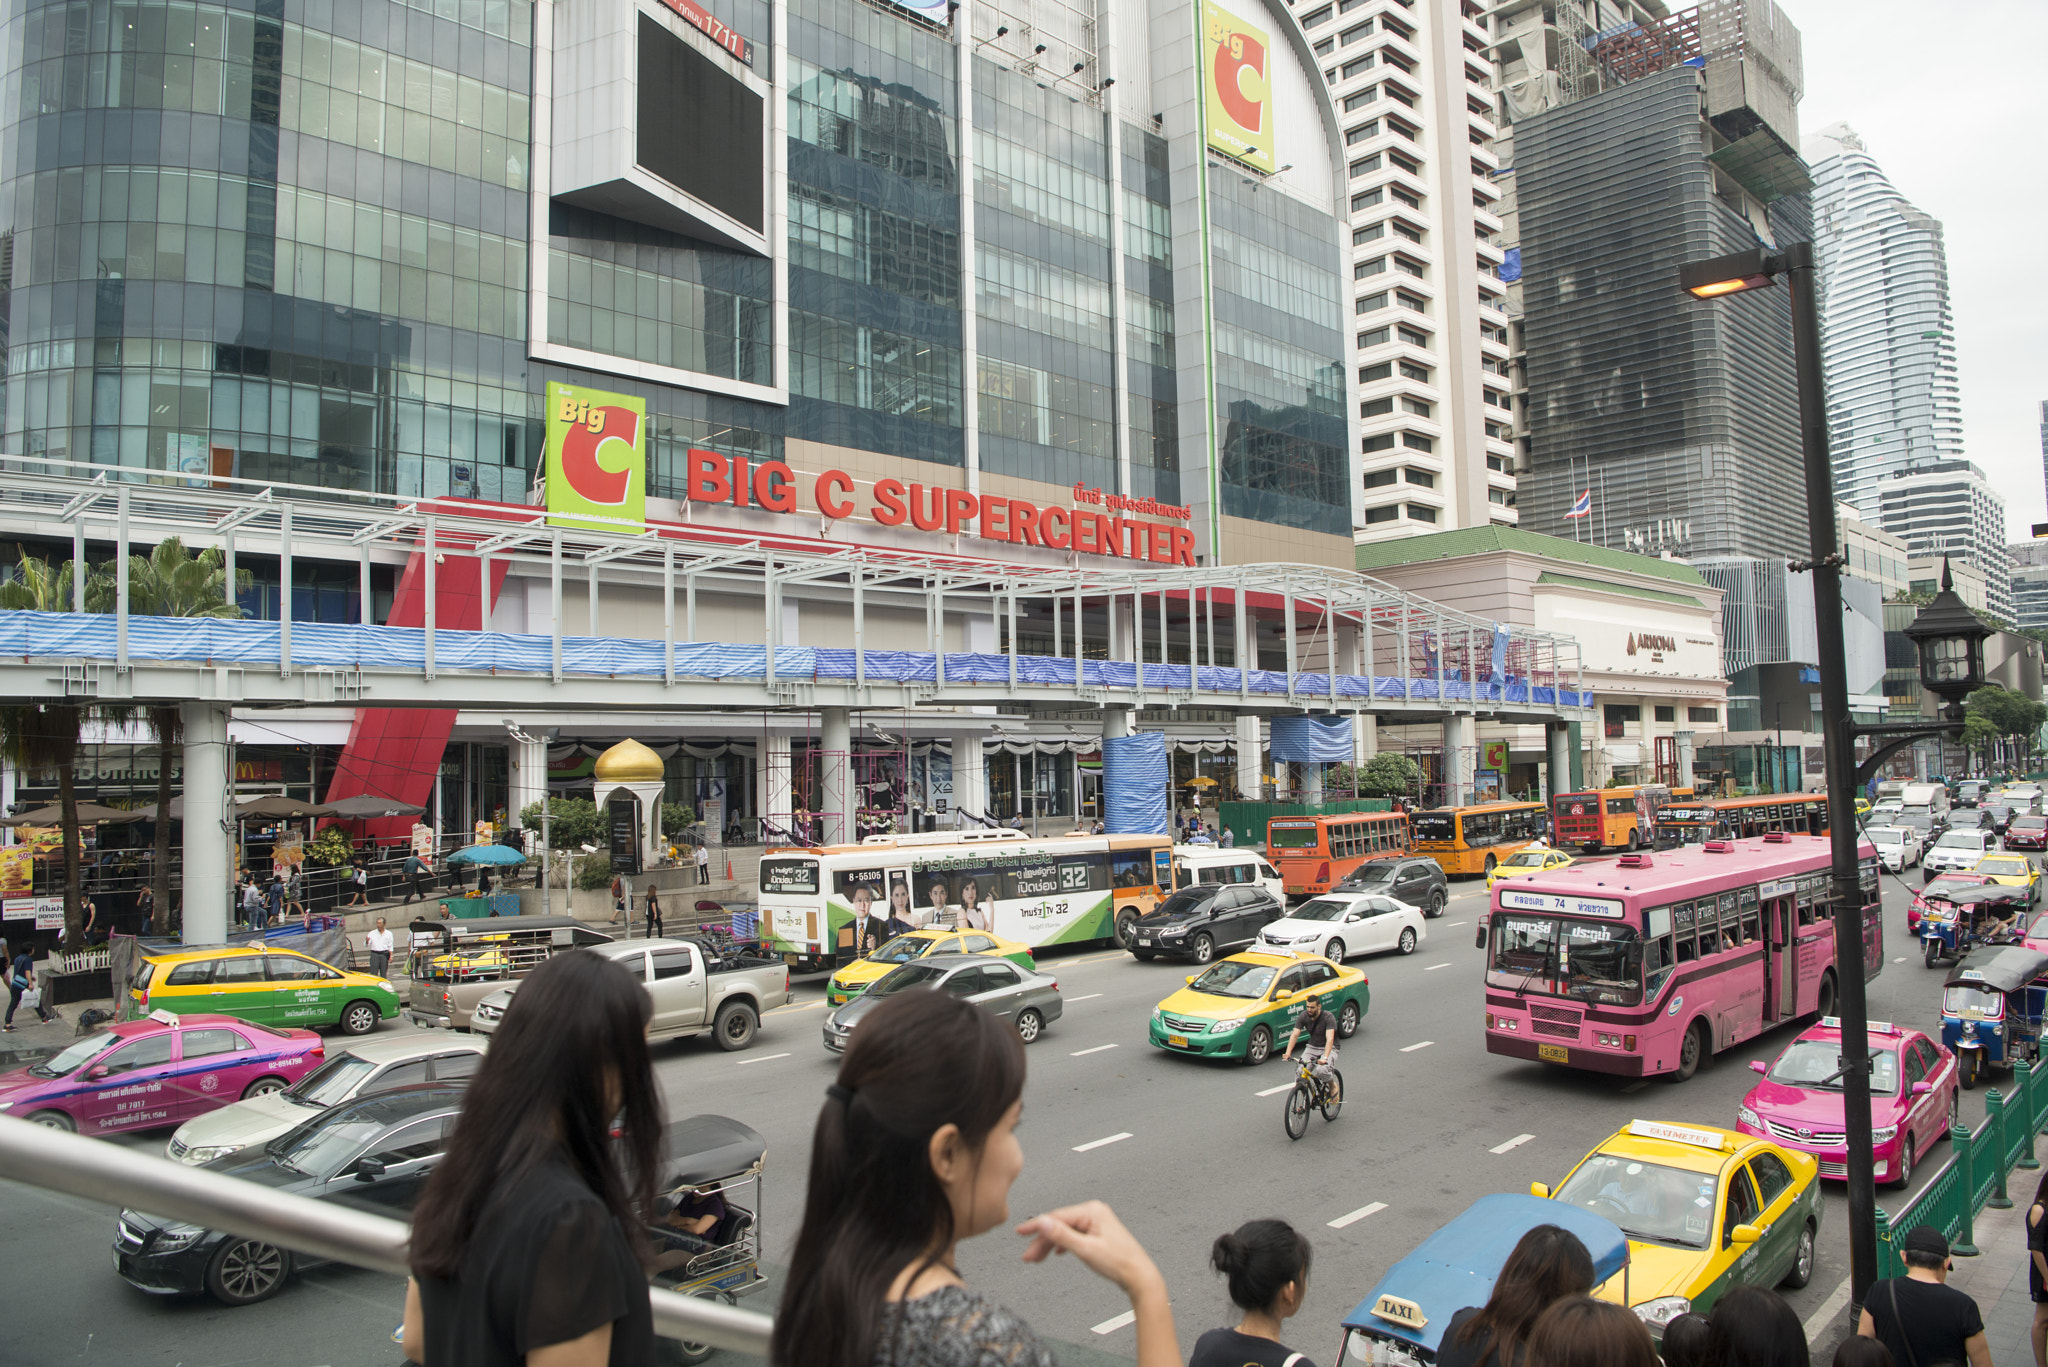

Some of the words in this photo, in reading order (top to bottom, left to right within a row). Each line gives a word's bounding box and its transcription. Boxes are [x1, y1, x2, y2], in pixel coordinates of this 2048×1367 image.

[706, 16, 738, 53] 1711
[1209, 17, 1245, 61] Big
[1214, 33, 1266, 135] C
[558, 397, 607, 434] Big
[561, 405, 640, 506] C
[687, 448, 797, 514] BIG
[814, 469, 855, 519] C
[871, 478, 1197, 567] SUPERCENTER
[1637, 632, 1677, 653] ARNOMA
[1212, 754, 1225, 763] bon
[794, 868, 809, 883] 32
[1061, 866, 1087, 889] 32
[1055, 903, 1069, 914] 32
[1514, 895, 1545, 906] คลองเตย
[1554, 898, 1566, 909] 74
[1577, 901, 1609, 914] ห้วยขวาง
[1506, 920, 1552, 935] อนุสาวรีย์
[1382, 1299, 1412, 1320] TAXI
